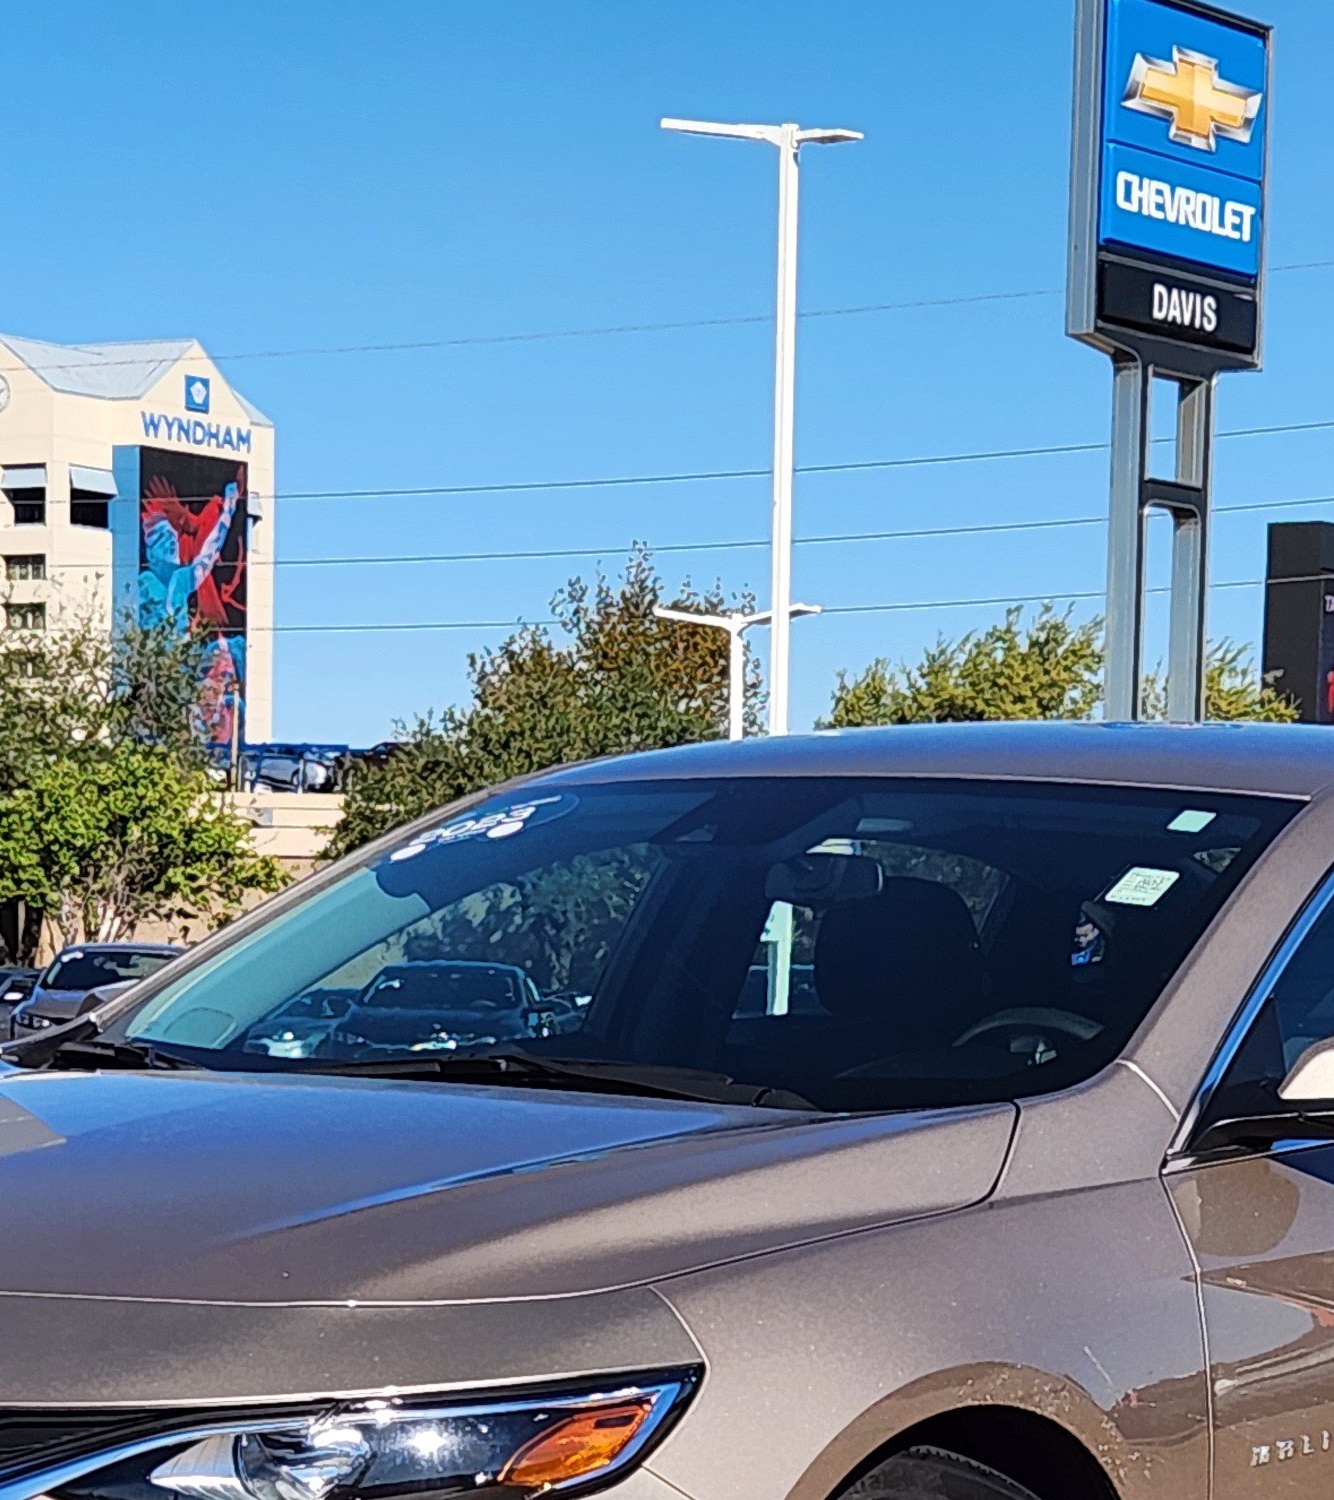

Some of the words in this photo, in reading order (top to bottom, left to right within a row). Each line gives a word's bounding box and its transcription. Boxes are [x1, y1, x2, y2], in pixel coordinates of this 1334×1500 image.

[1116, 170, 1256, 243] CHEVROLET
[1152, 283, 1218, 332] DAVIS
[141, 410, 252, 453] WYNDHAM
